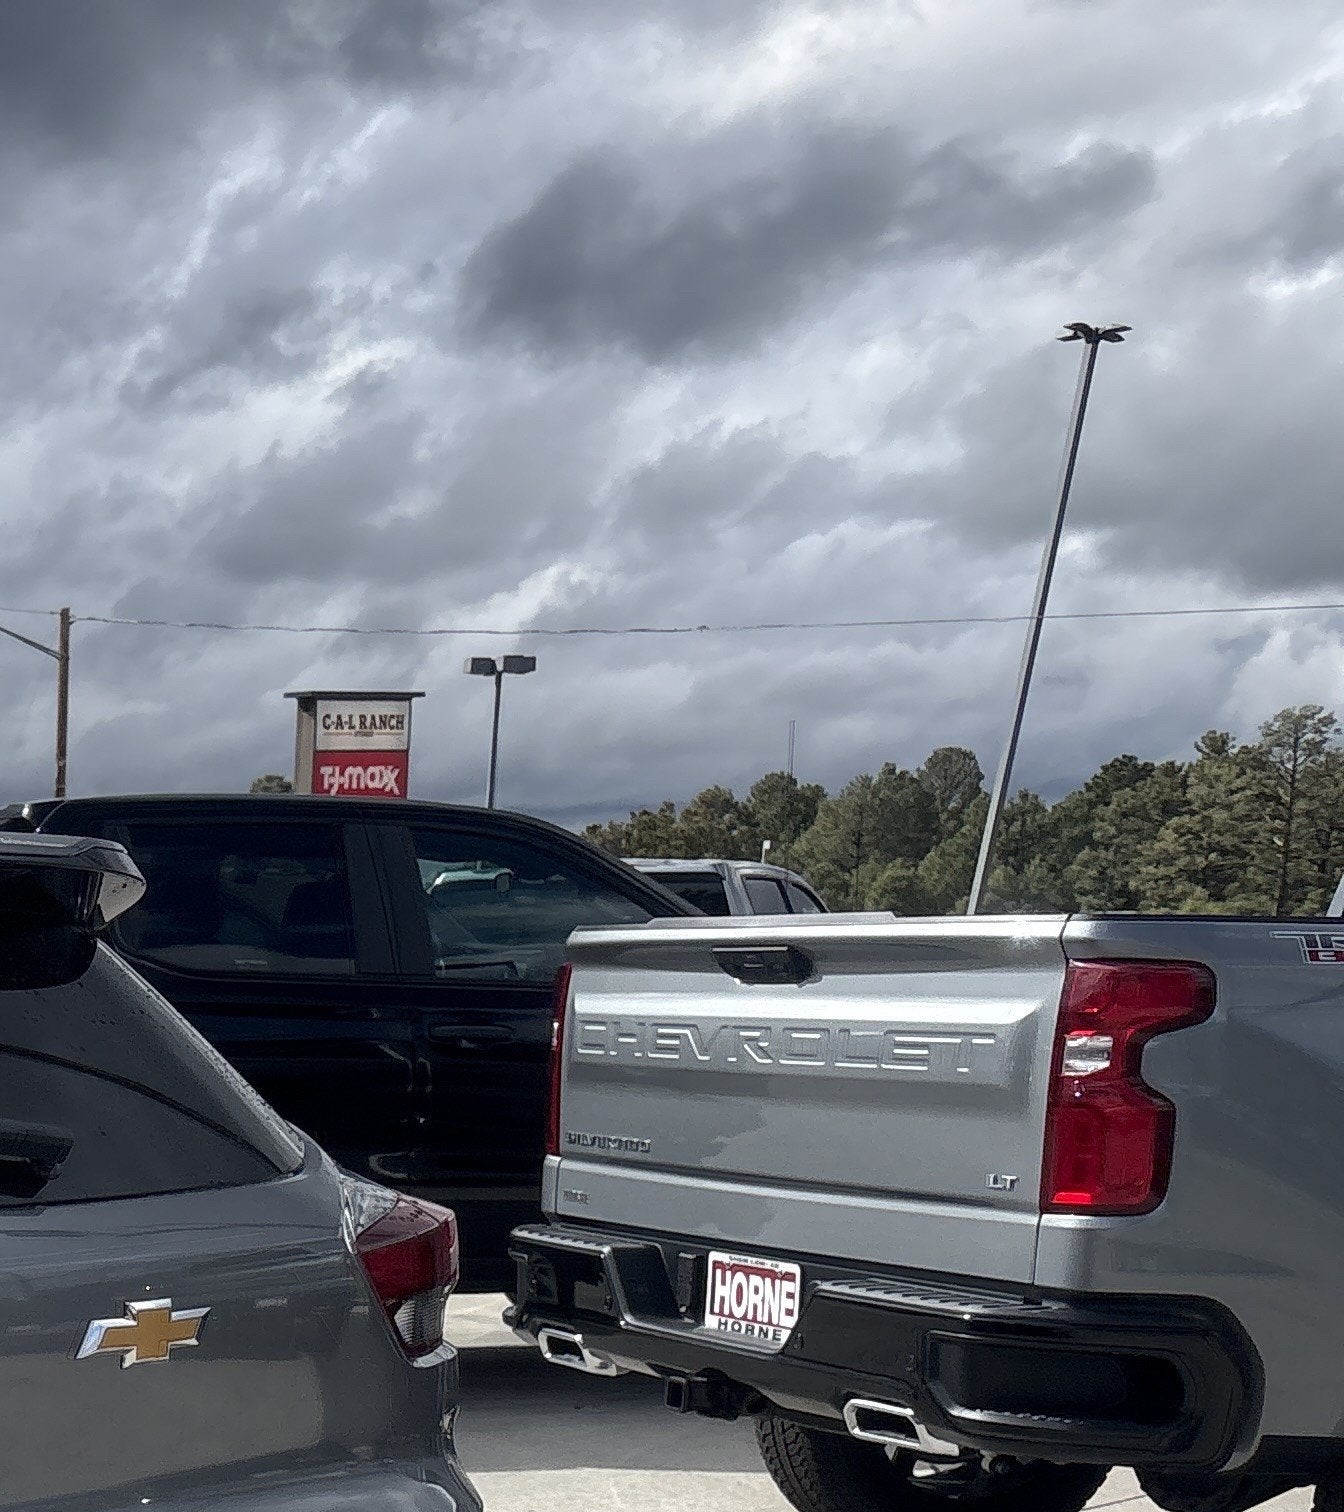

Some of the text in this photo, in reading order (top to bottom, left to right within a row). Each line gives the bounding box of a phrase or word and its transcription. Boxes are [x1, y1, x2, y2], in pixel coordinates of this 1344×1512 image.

[359, 714, 404, 730] RANCH
[575, 1020, 999, 1073] CHEVROLET
[985, 1173, 1020, 1192] LT
[713, 1267, 796, 1328] HORNE
[717, 1318, 783, 1342] HORNE
